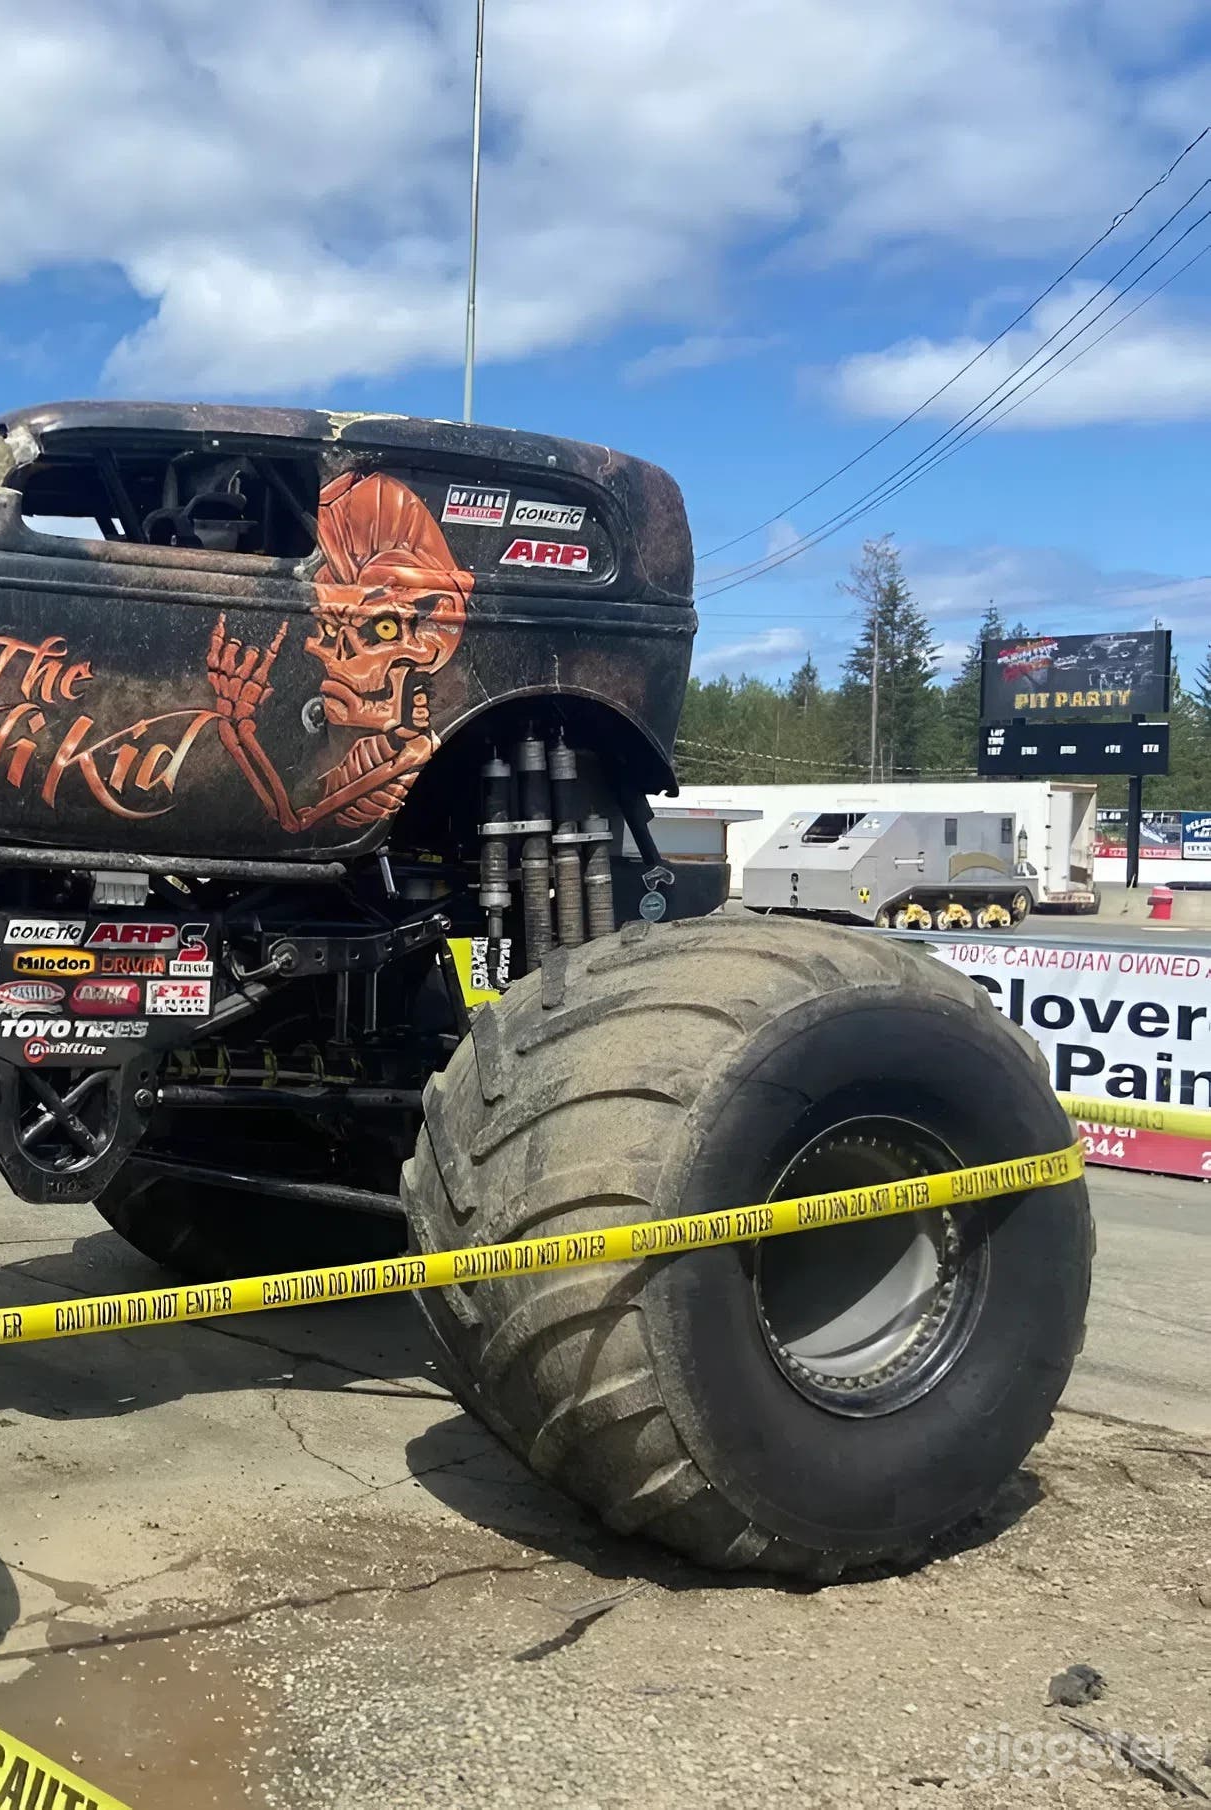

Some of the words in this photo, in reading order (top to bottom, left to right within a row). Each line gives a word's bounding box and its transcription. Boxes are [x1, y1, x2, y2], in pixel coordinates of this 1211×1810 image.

[505, 541, 587, 566] ARP
[1014, 693, 1050, 709] PIT
[1054, 689, 1131, 708] PARTY
[10, 923, 82, 940] COMETIC
[90, 924, 177, 943] ARP
[17, 956, 91, 971] Milodon
[950, 944, 997, 965] 100%
[1003, 946, 1111, 972] CANADIAN
[1118, 953, 1201, 978] OWNED
[0, 1020, 72, 1037] TOYO
[74, 1020, 149, 1037] TIRES
[631, 1223, 686, 1252] CAUTION
[689, 1220, 707, 1243] DO
[709, 1215, 731, 1241] NOT
[262, 1274, 325, 1306] CAUTION
[329, 1271, 347, 1296] DO
[55, 1300, 122, 1333] CAUTION
[127, 1298, 147, 1324] DO
[152, 1293, 179, 1319] NOT
[186, 1286, 233, 1315] ENTER
